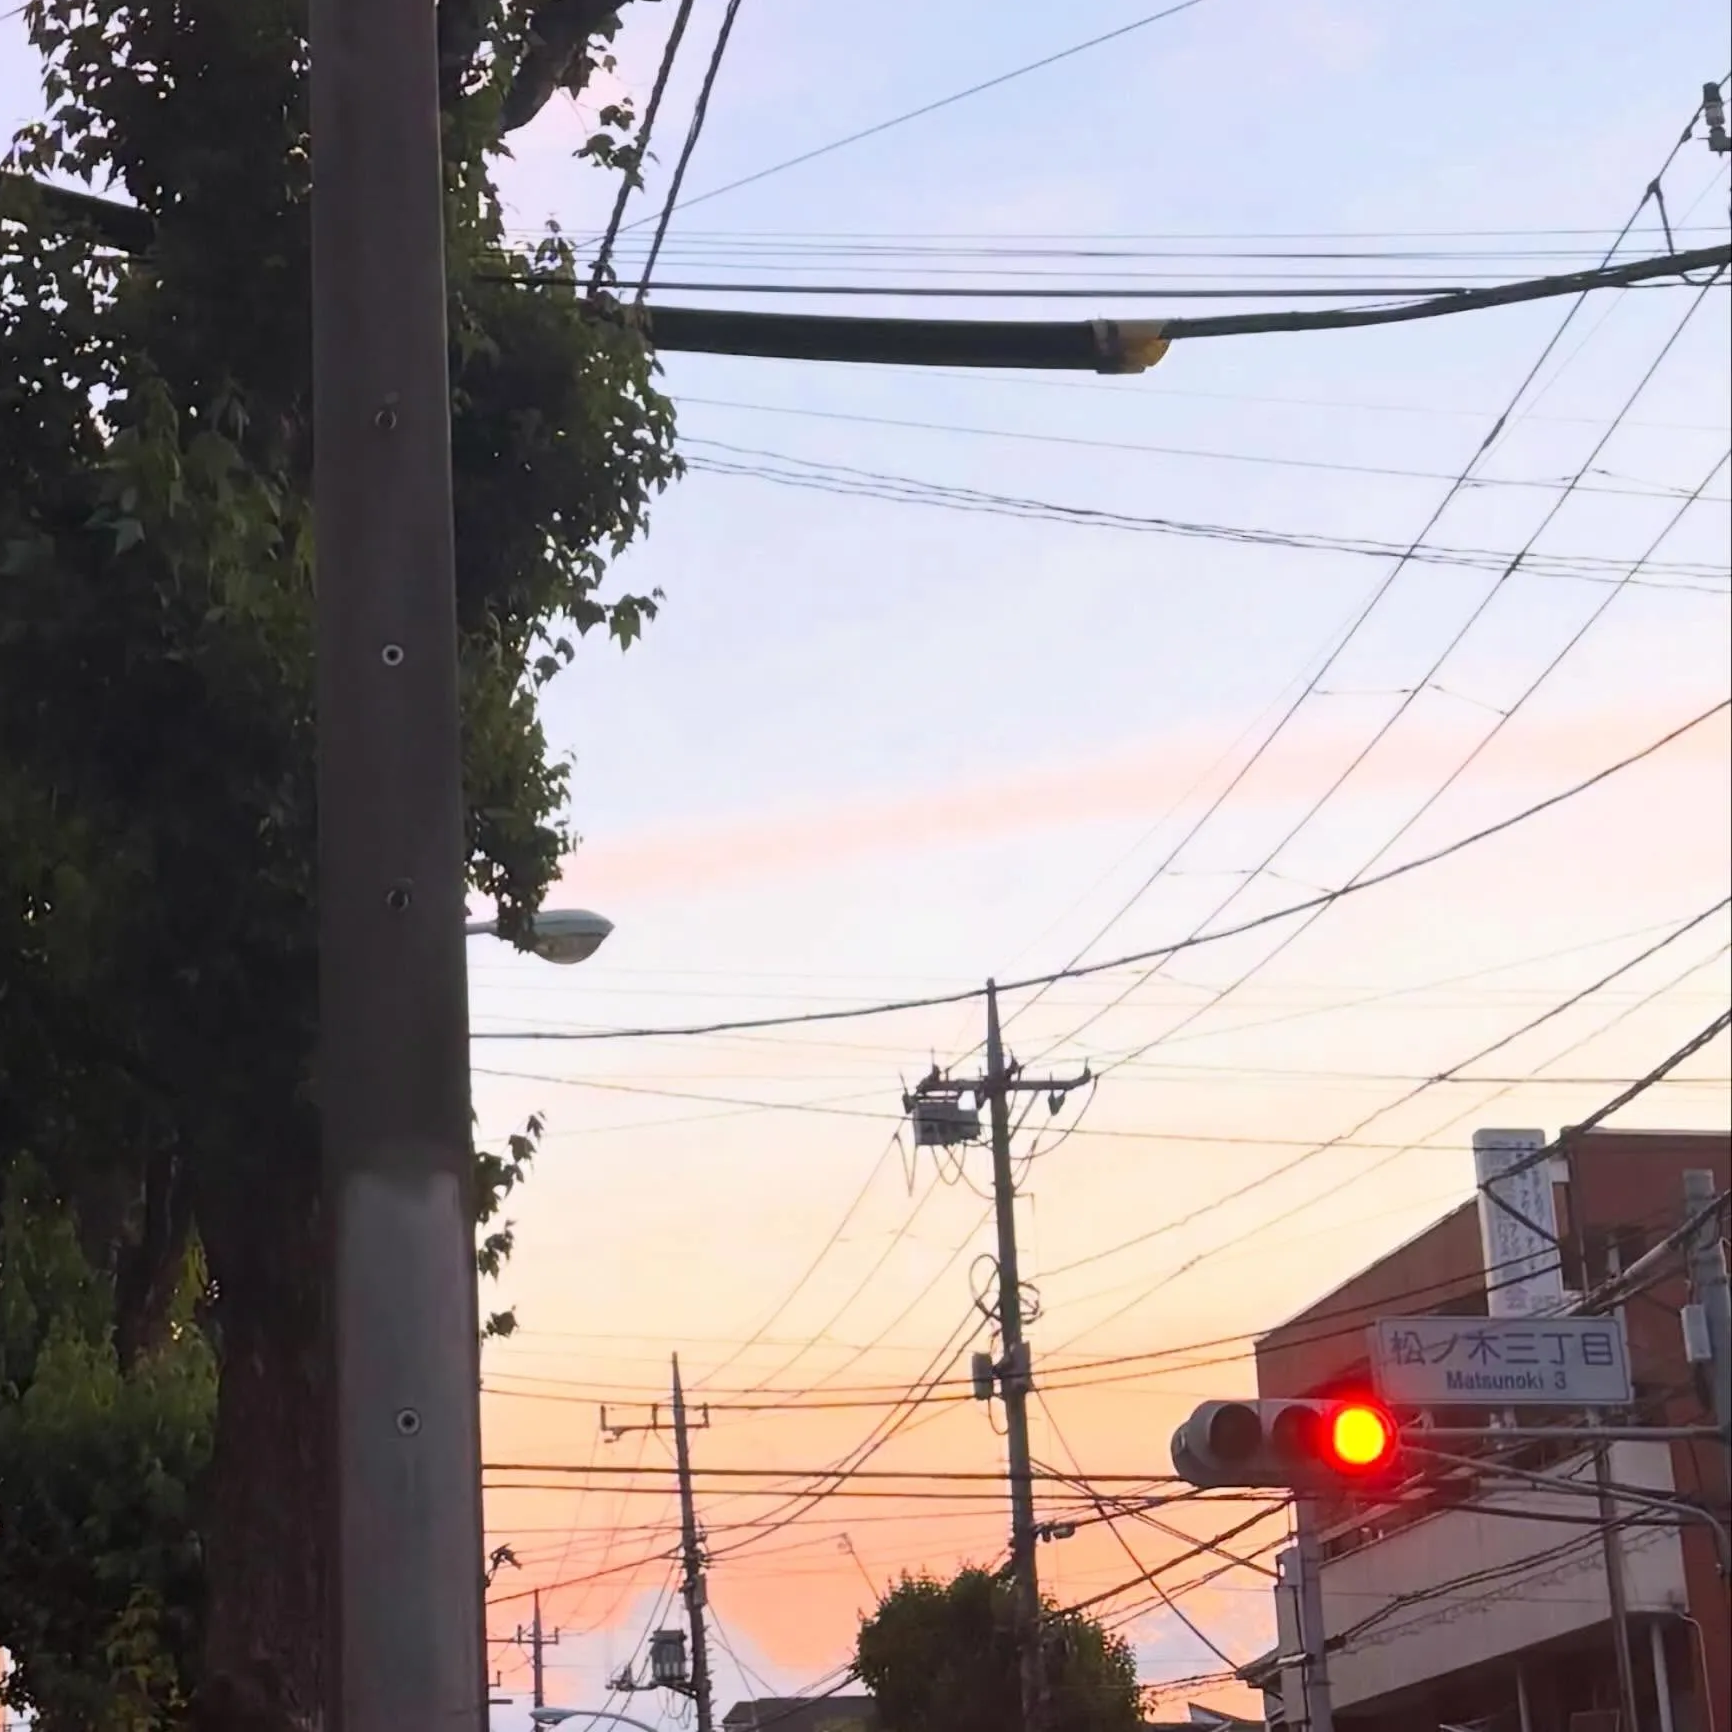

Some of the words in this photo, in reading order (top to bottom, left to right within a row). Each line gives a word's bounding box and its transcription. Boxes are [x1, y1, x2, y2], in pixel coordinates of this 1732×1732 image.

[1390, 1330, 1614, 1367] 松ノ木三丁目
[1446, 1371, 1545, 1391] Matsunoki
[1554, 1371, 1567, 1391] 3
